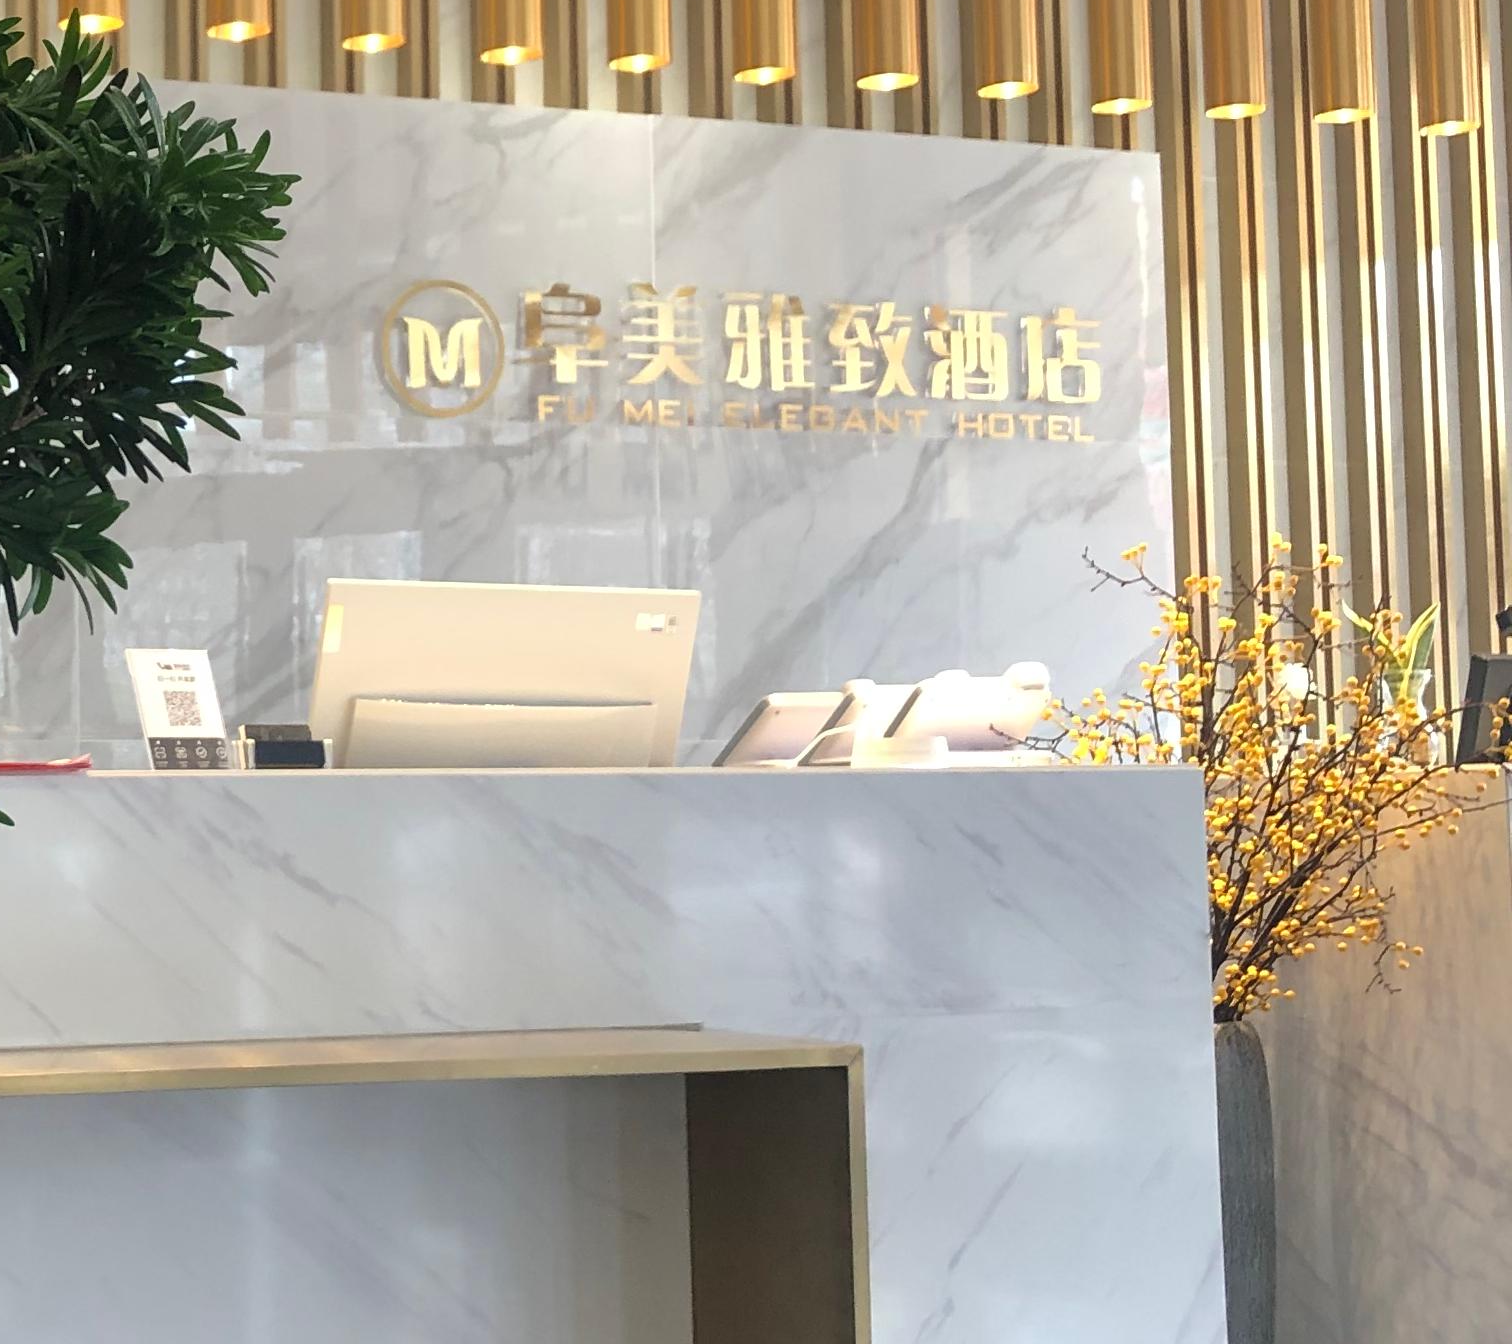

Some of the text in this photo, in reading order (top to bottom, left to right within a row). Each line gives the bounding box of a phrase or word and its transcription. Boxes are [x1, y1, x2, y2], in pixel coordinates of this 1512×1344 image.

[404, 316, 483, 390] M
[514, 282, 1102, 404] 阜美雅致酒店
[537, 394, 1096, 442] FU MEI ELEGANT HOTEL
